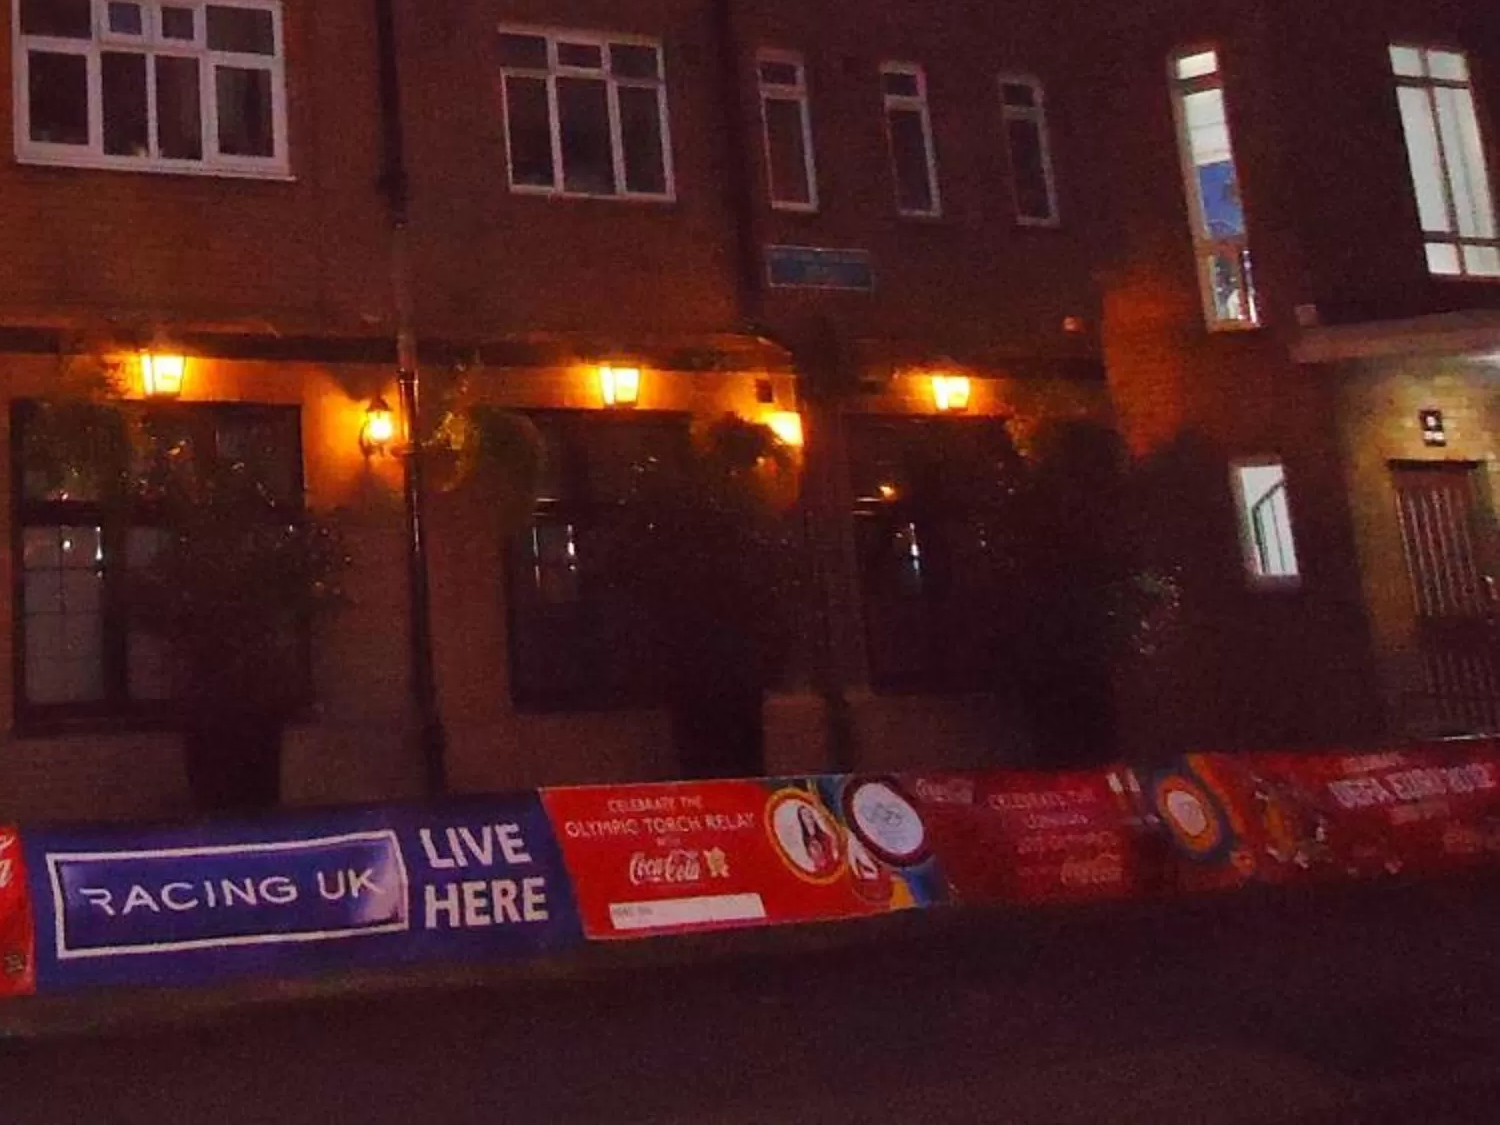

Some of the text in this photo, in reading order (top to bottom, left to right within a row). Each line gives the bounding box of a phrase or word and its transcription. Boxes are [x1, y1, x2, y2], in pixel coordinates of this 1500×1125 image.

[419, 821, 532, 869] LIVE
[565, 812, 755, 839] OLYMPIC TORCH RELAY
[78, 868, 381, 917] RACING UK
[424, 877, 549, 929] HERE
